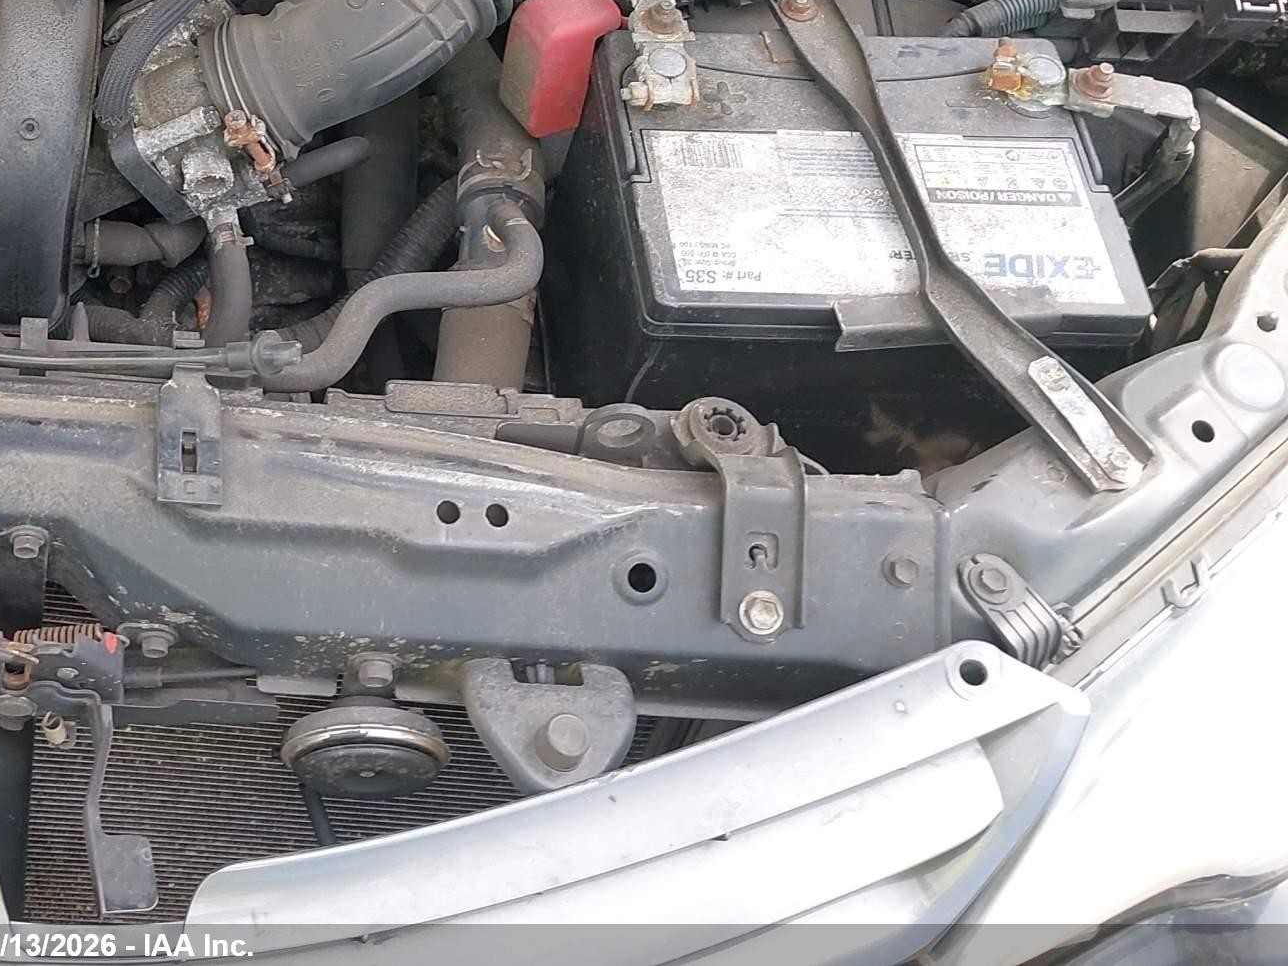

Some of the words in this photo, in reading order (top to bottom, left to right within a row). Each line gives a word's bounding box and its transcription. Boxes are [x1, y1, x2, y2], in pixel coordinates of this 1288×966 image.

[984, 252, 1102, 280] EXIDE
[685, 268, 718, 284] S35
[737, 270, 762, 282] Part
